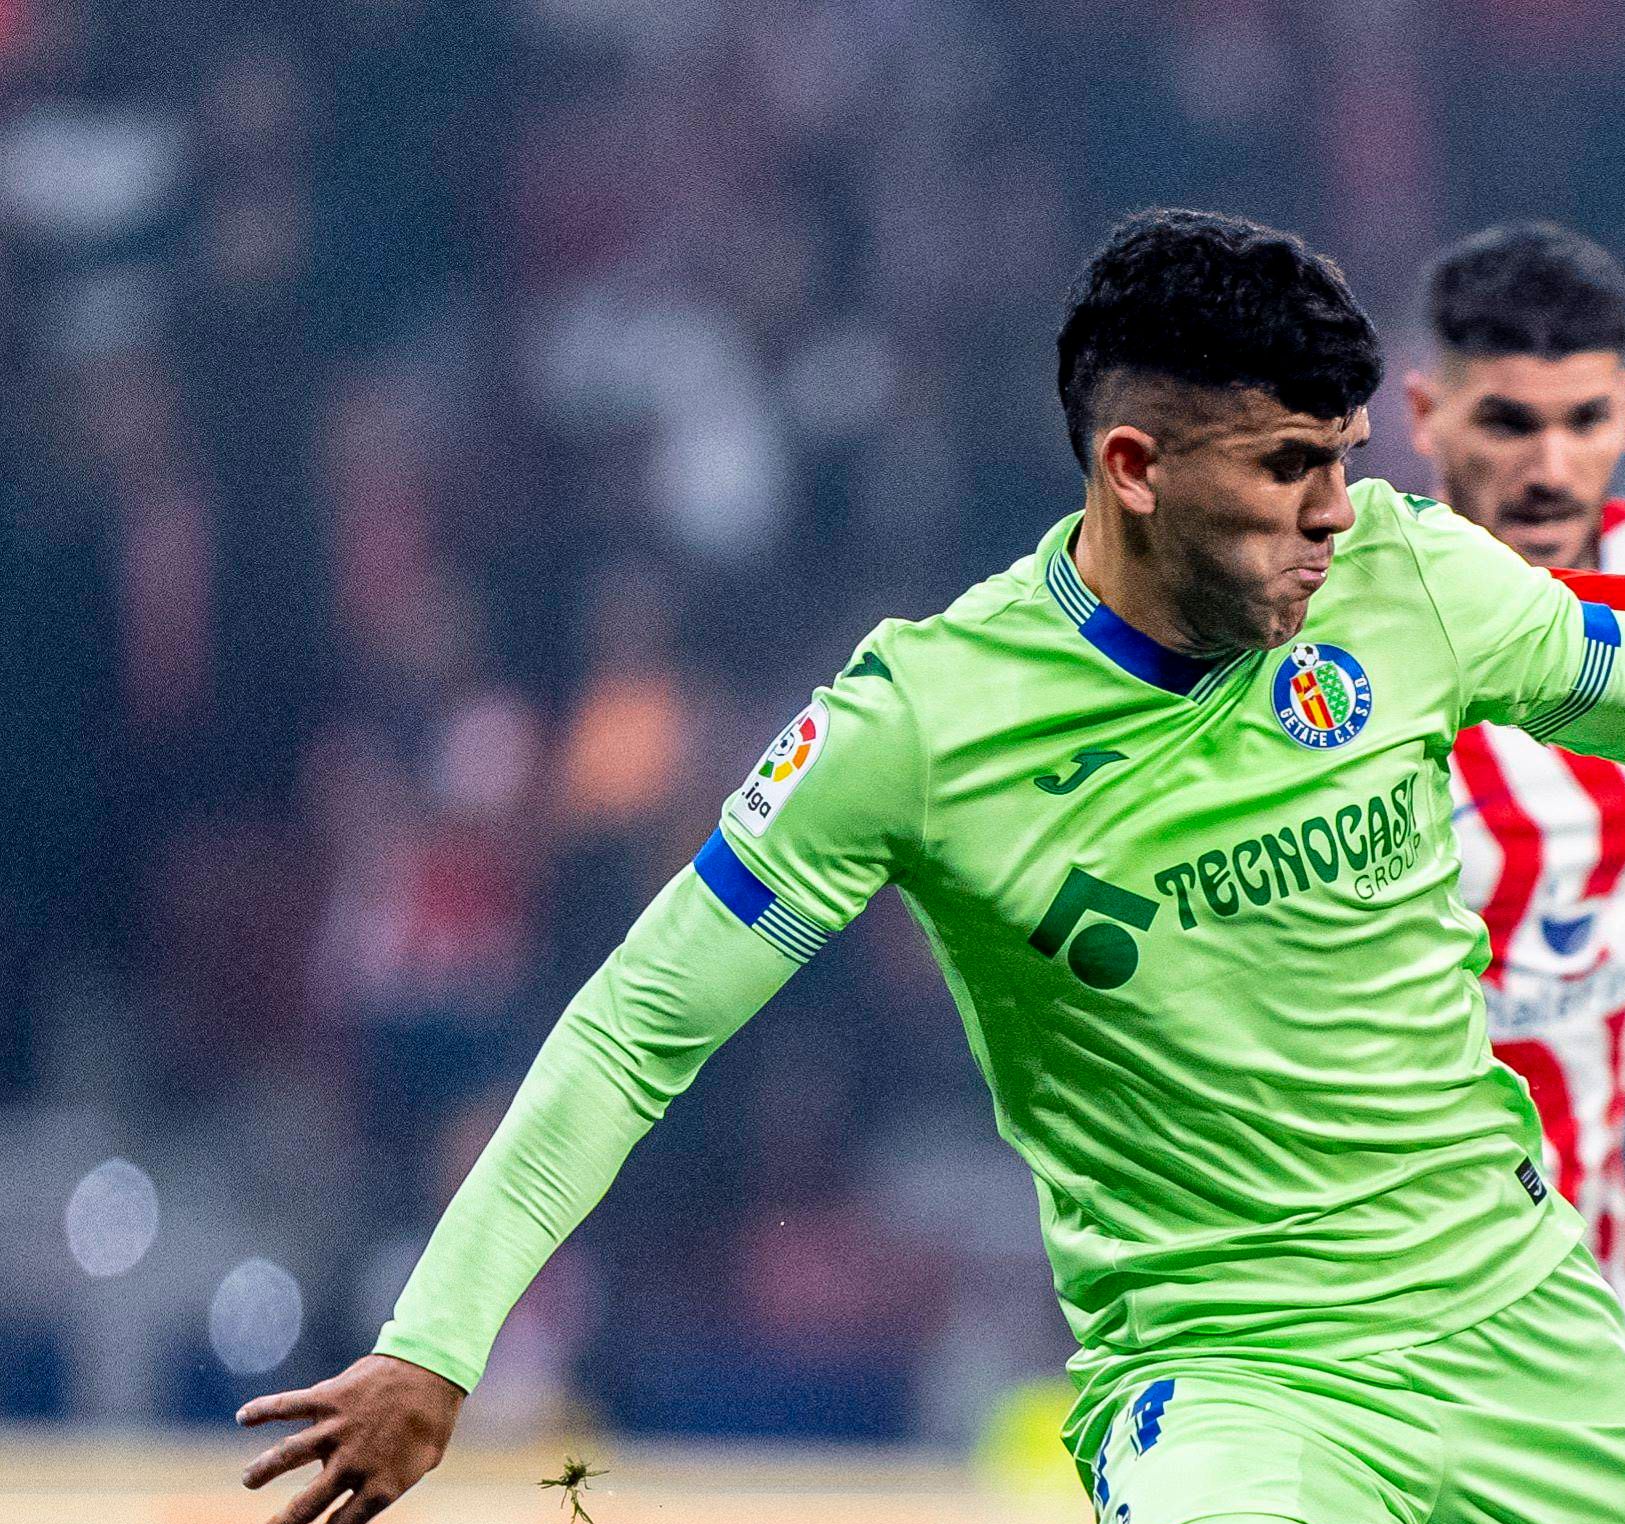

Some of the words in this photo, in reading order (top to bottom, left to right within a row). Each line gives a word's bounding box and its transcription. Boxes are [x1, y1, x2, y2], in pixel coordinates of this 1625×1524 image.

[1280, 707, 1328, 747] GETAFE
[1334, 720, 1360, 744] C.F.
[1354, 832, 1421, 900] GROUP
